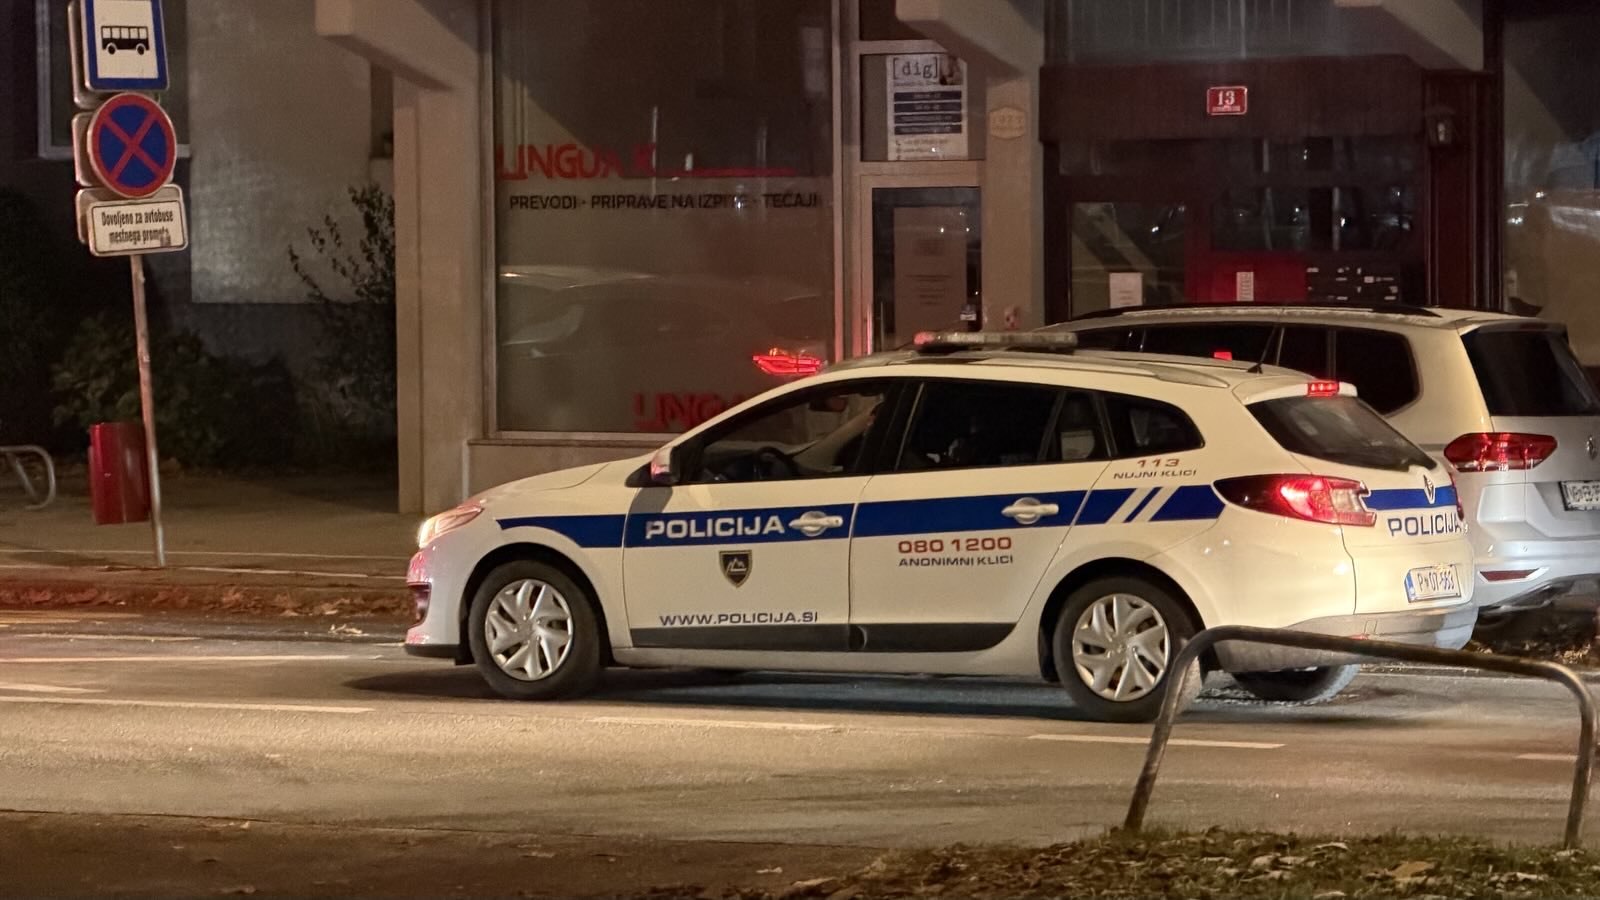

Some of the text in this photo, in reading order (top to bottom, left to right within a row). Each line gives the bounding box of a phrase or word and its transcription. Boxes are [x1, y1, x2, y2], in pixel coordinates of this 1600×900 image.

[1217, 90, 1236, 106] 13
[496, 143, 625, 181] LINGUA
[509, 194, 577, 210] PREVODI
[591, 194, 668, 210] PRIPRAVE
[671, 194, 695, 209] NA
[102, 209, 173, 227] Dovoljeno za avtobuse
[109, 230, 140, 245] mestnega
[1137, 458, 1180, 469] 113
[1113, 469, 1197, 480] NUJNI KLICI
[645, 515, 785, 540] POLICIJA
[1387, 513, 1462, 537] POLICIJA
[898, 536, 1012, 554] 080 1200
[899, 555, 1013, 567] ANONIMNI KLICI
[659, 610, 818, 627] WWW.POLICIJA.SI
